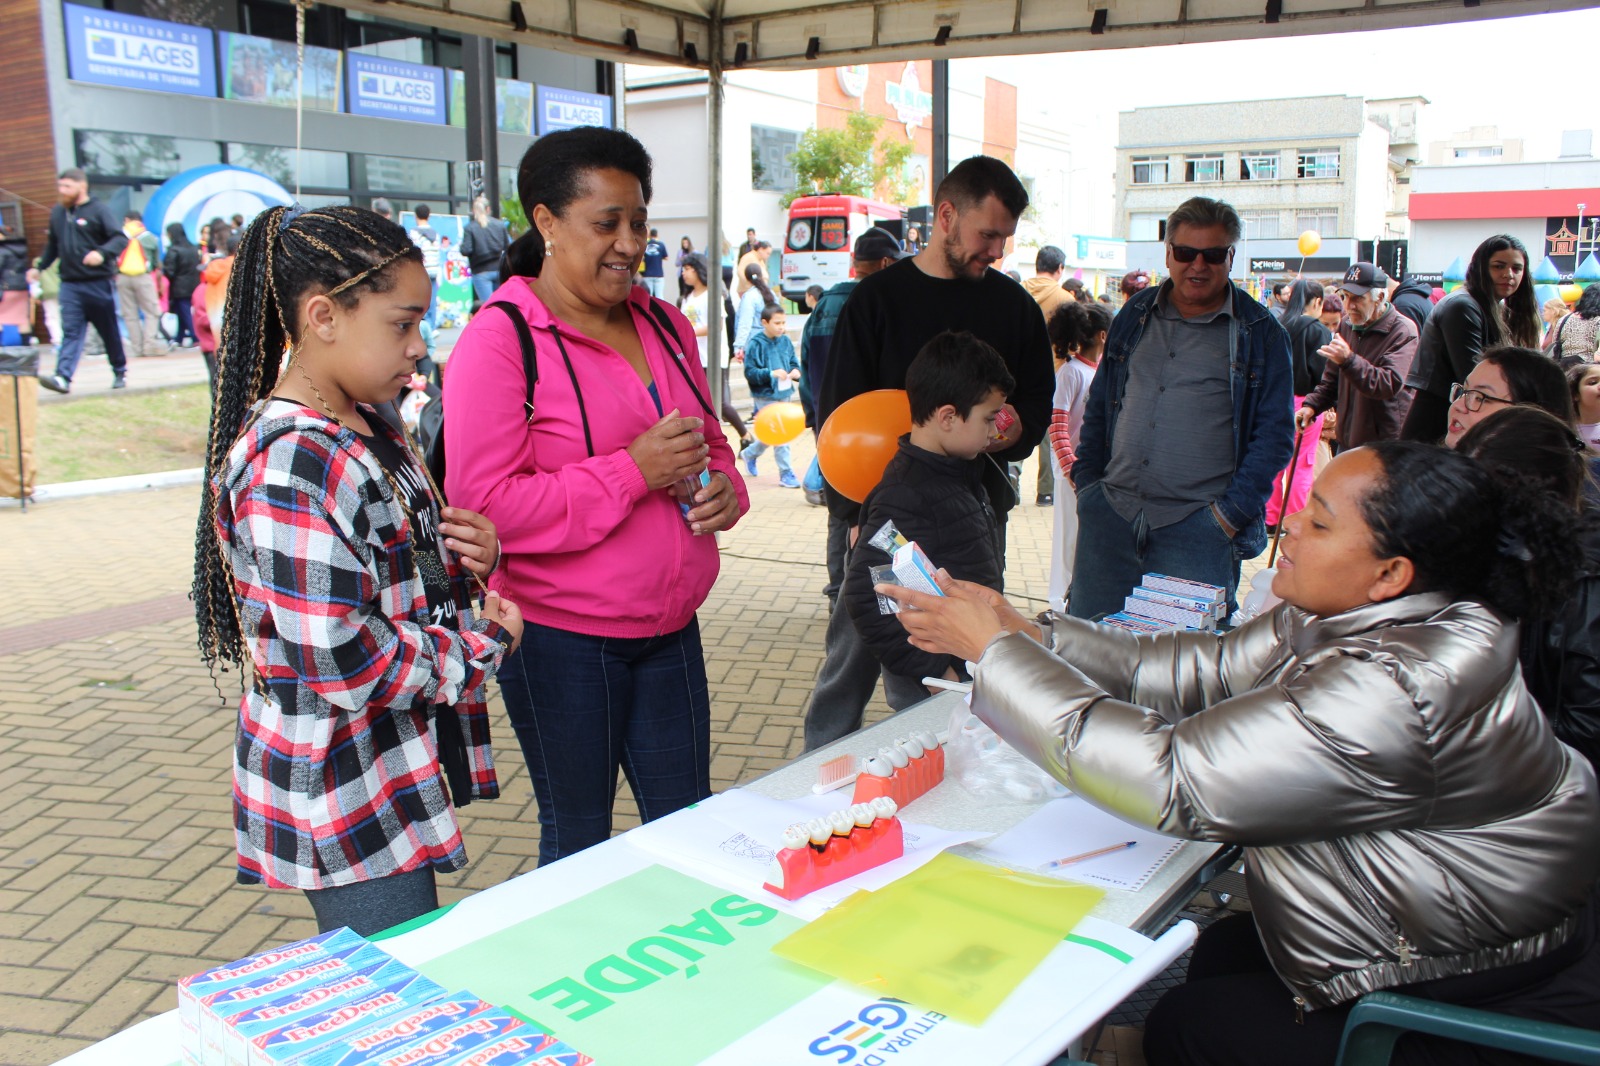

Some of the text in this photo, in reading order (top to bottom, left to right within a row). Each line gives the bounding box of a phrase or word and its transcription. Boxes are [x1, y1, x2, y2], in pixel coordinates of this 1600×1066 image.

[83, 15, 198, 44] PREFEITURA DE
[123, 39, 194, 69] LAGES
[87, 63, 199, 87] SECRETARIA DE TURISMO
[357, 60, 435, 80] PREFEITURA DE
[383, 79, 431, 101] LAGES
[359, 99, 436, 116] SECRETARIA DE TURISMO
[564, 105, 600, 125] LAGES
[821, 222, 844, 231] SAMU
[821, 231, 843, 245] 192
[1263, 260, 1285, 269] Hering
[1411, 273, 1443, 282] Utens
[209, 943, 320, 981] FreeDent
[292, 947, 329, 963] Menta
[528, 894, 778, 1022] SAÚDE
[231, 959, 346, 1000] FreeDent
[318, 965, 353, 981] Menta
[255, 976, 371, 1020] FreeDent
[342, 982, 379, 998] Menta
[285, 993, 399, 1041] FreeDent
[372, 1001, 408, 1018] Menta
[351, 1001, 463, 1050] FreeDent
[808, 998, 915, 1065] GES
[877, 1010, 947, 1053] EITURA
[382, 1018, 497, 1066] FreeDent
[459, 1037, 530, 1066] Free
